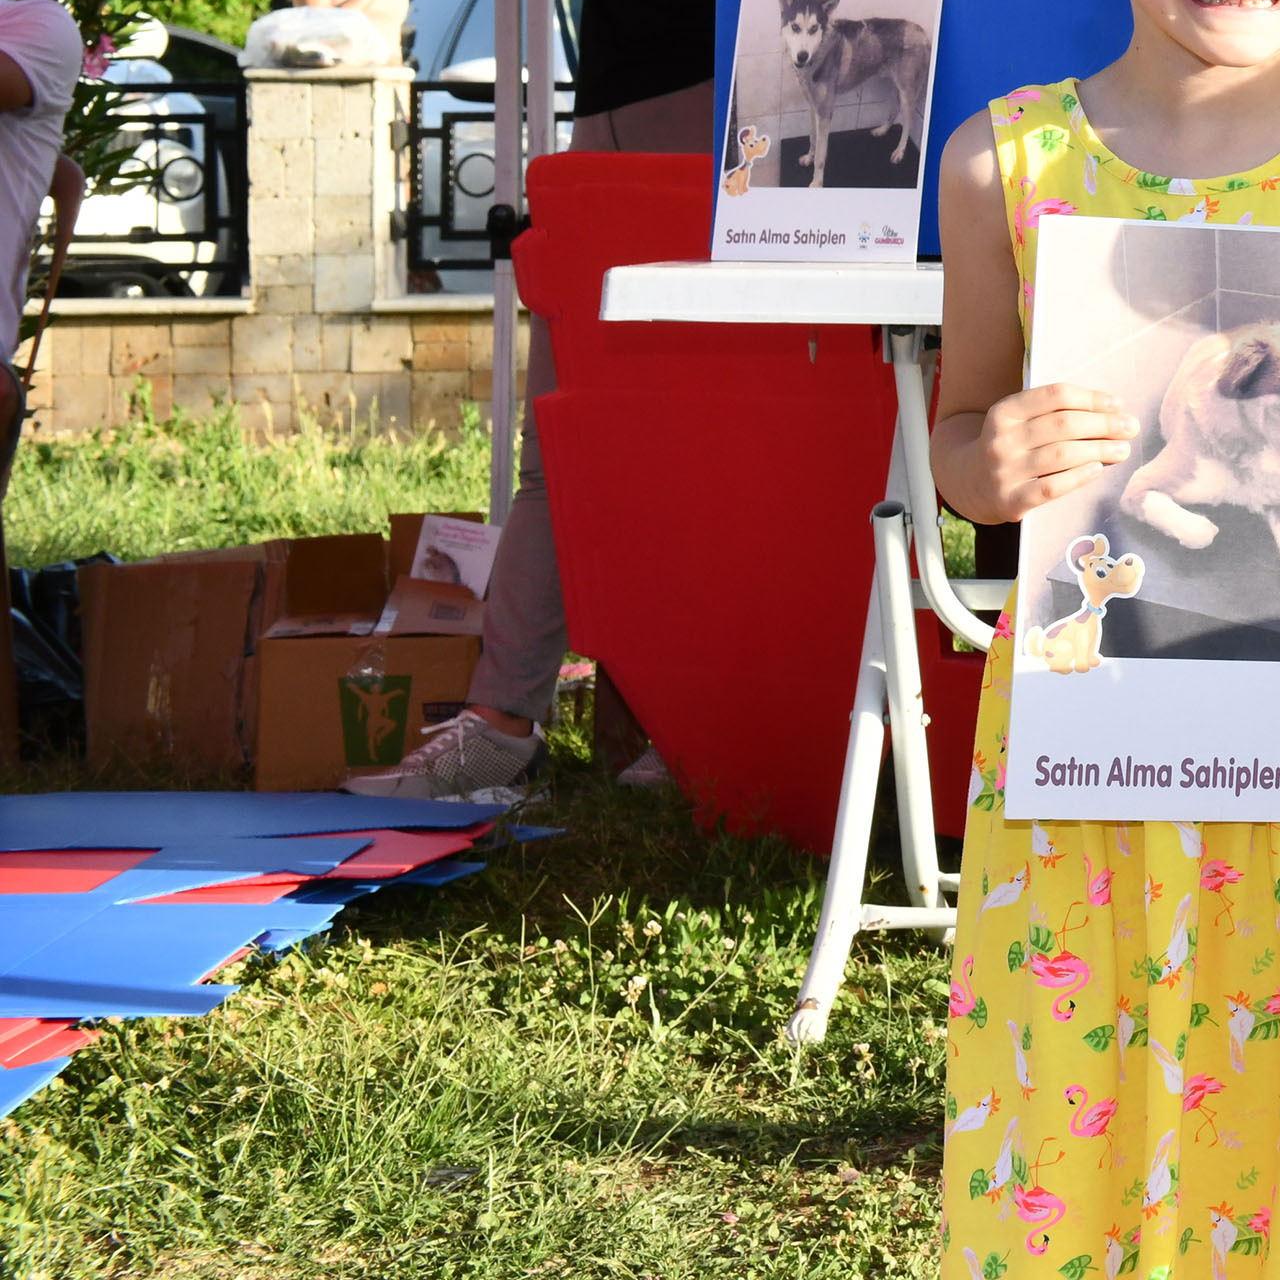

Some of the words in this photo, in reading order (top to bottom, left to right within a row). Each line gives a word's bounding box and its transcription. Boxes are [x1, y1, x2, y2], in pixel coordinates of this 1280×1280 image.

[726, 228, 756, 245] Satın
[759, 229, 790, 245] Alma
[793, 228, 846, 248] Sahiplen
[1035, 755, 1100, 787] Satın
[1106, 755, 1172, 788] Alma
